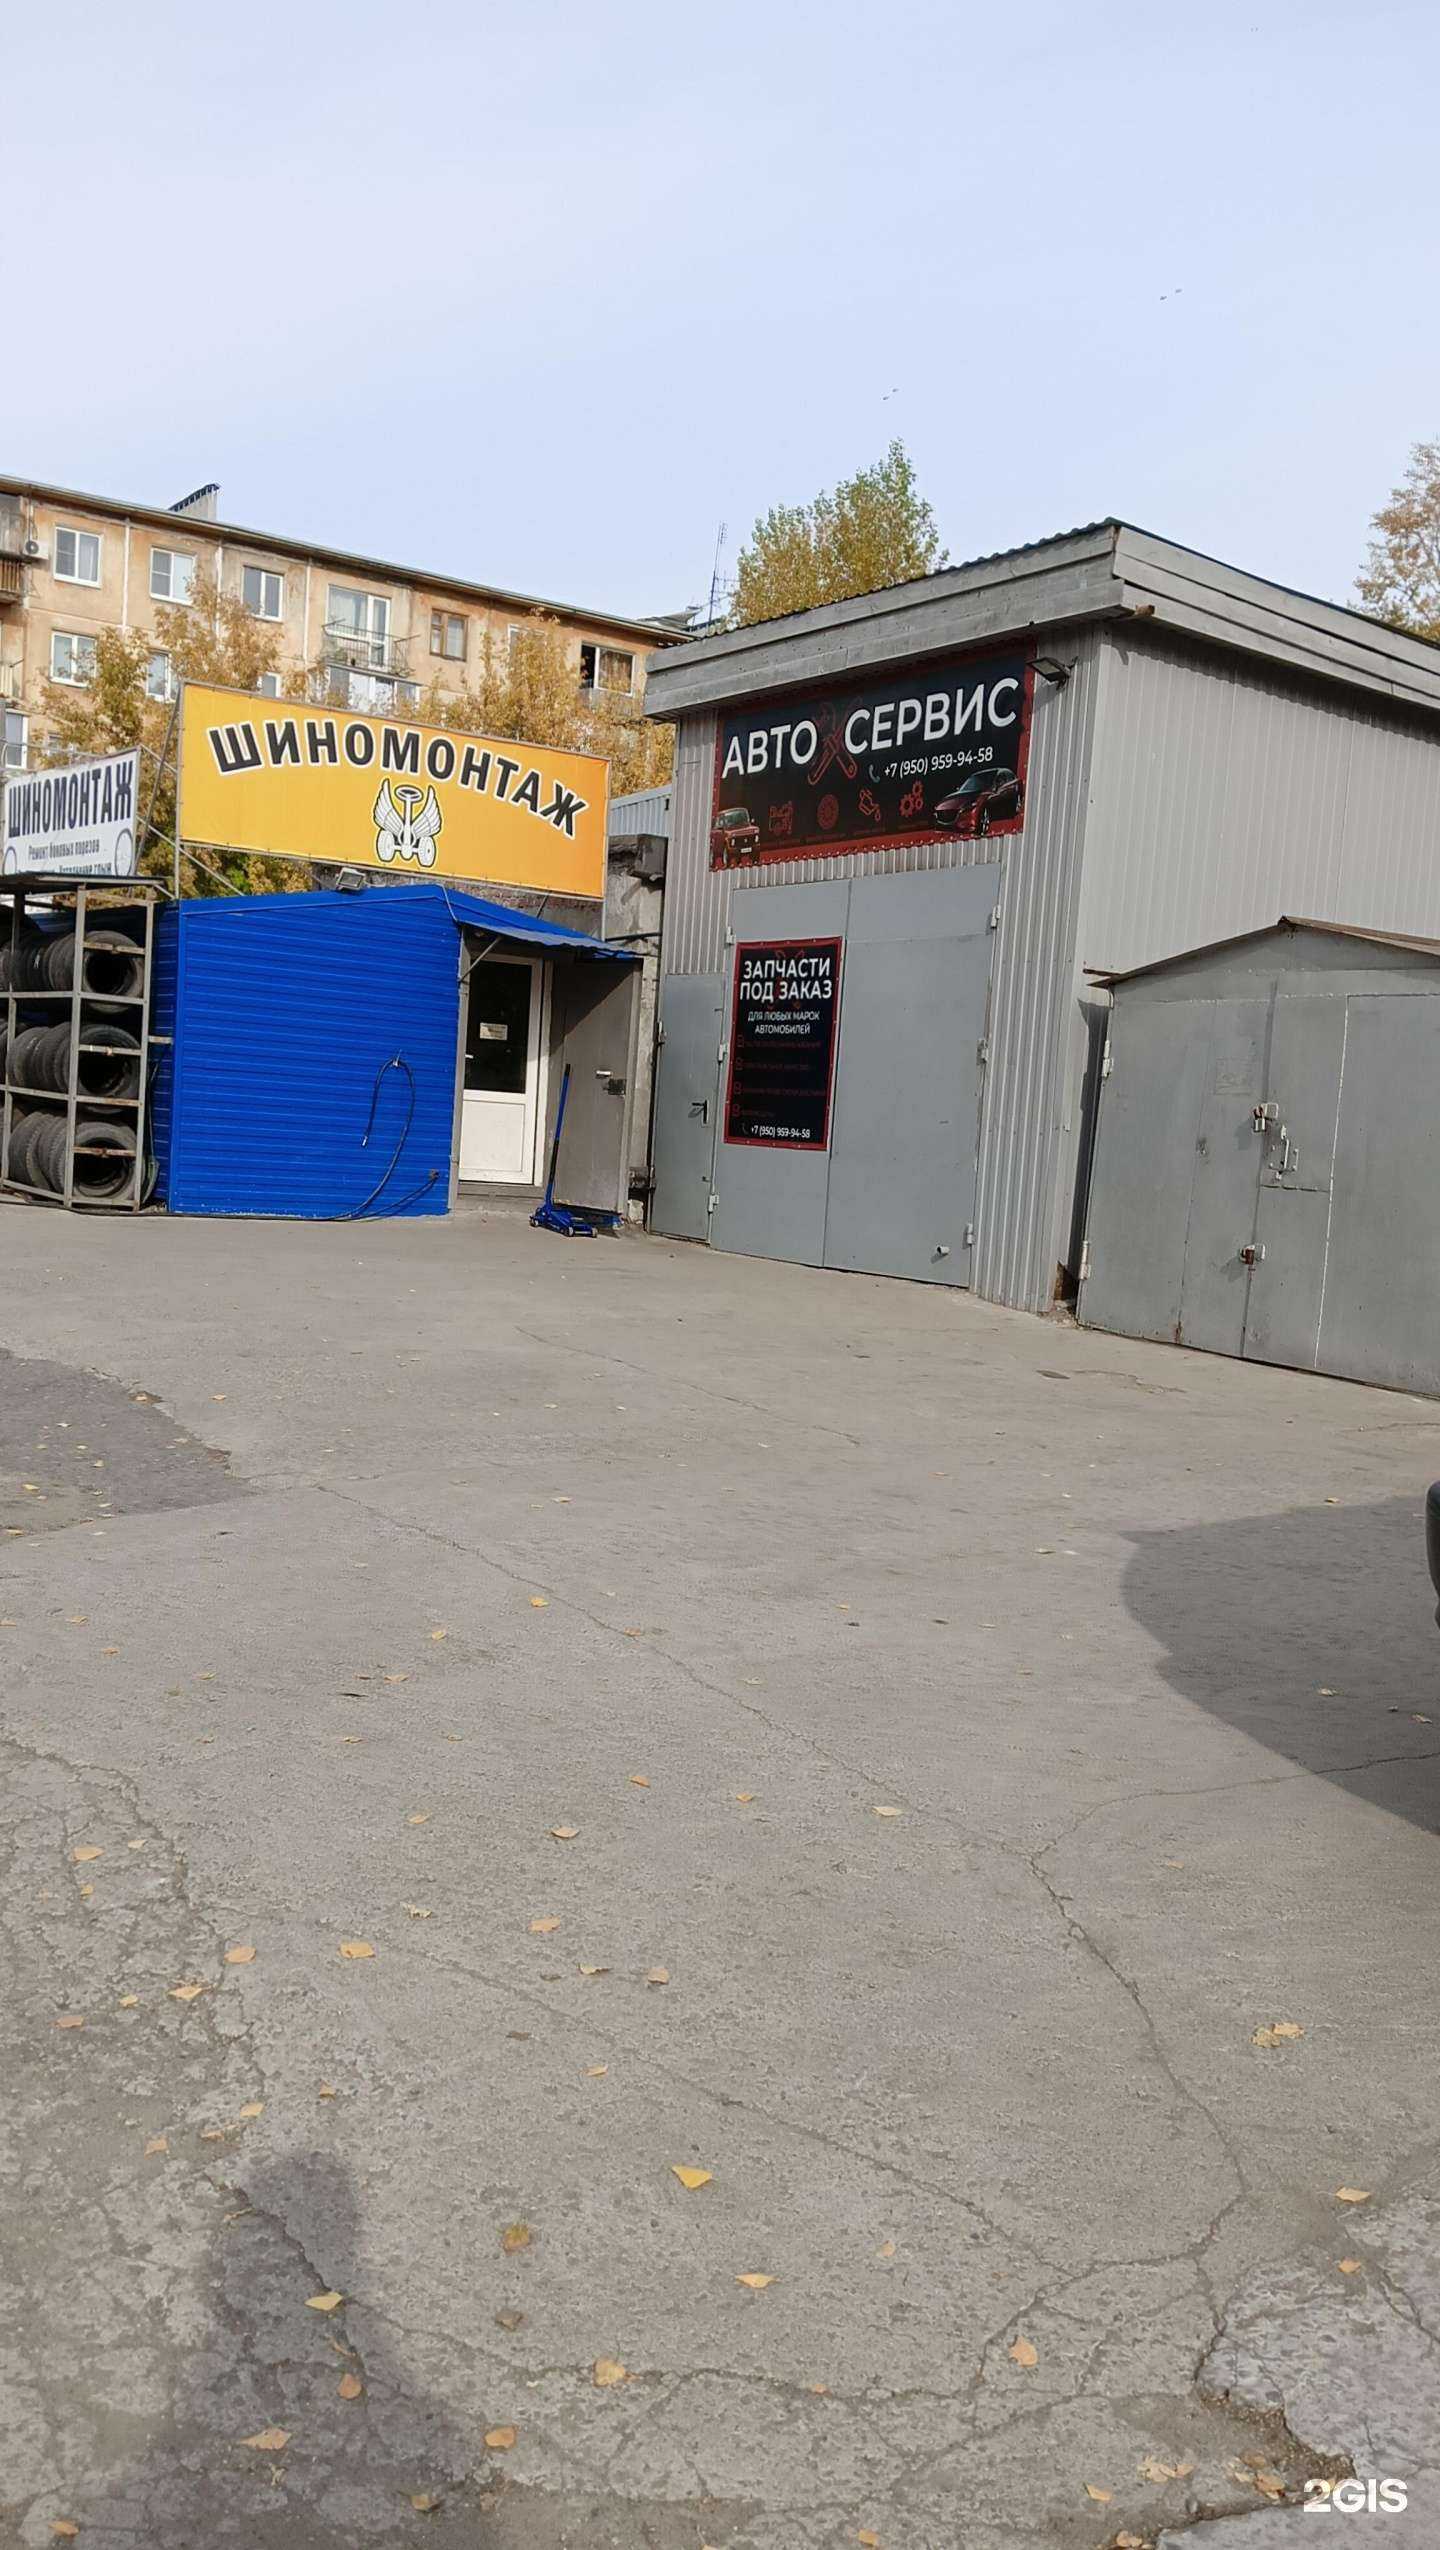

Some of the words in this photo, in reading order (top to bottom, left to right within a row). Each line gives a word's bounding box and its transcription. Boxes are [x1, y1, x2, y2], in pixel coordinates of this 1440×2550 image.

[722, 720, 818, 779] АВТО
[844, 677, 1020, 754] СЕРВИС
[884, 762, 898, 779] +7
[900, 756, 928, 778] (950)
[931, 746, 993, 772] 959-94-58
[207, 720, 588, 839] ШИНОМОНТАЖ
[8, 760, 134, 839] ШИНОМОНТАЖ
[743, 957, 831, 979] ЗАПЧАСТИ
[740, 981, 774, 1004] ПОД
[778, 979, 833, 1000] ЗАКАЗ
[748, 1011, 763, 1022] ДЛЯ
[764, 1011, 792, 1021] ЛЮБЫХ
[793, 1010, 820, 1021] МАРОК
[755, 1022, 811, 1034] АВТОМОБИЛЕЙ
[760, 1125, 776, 1138] (950)
[776, 1127, 811, 1139] 959-94-58
